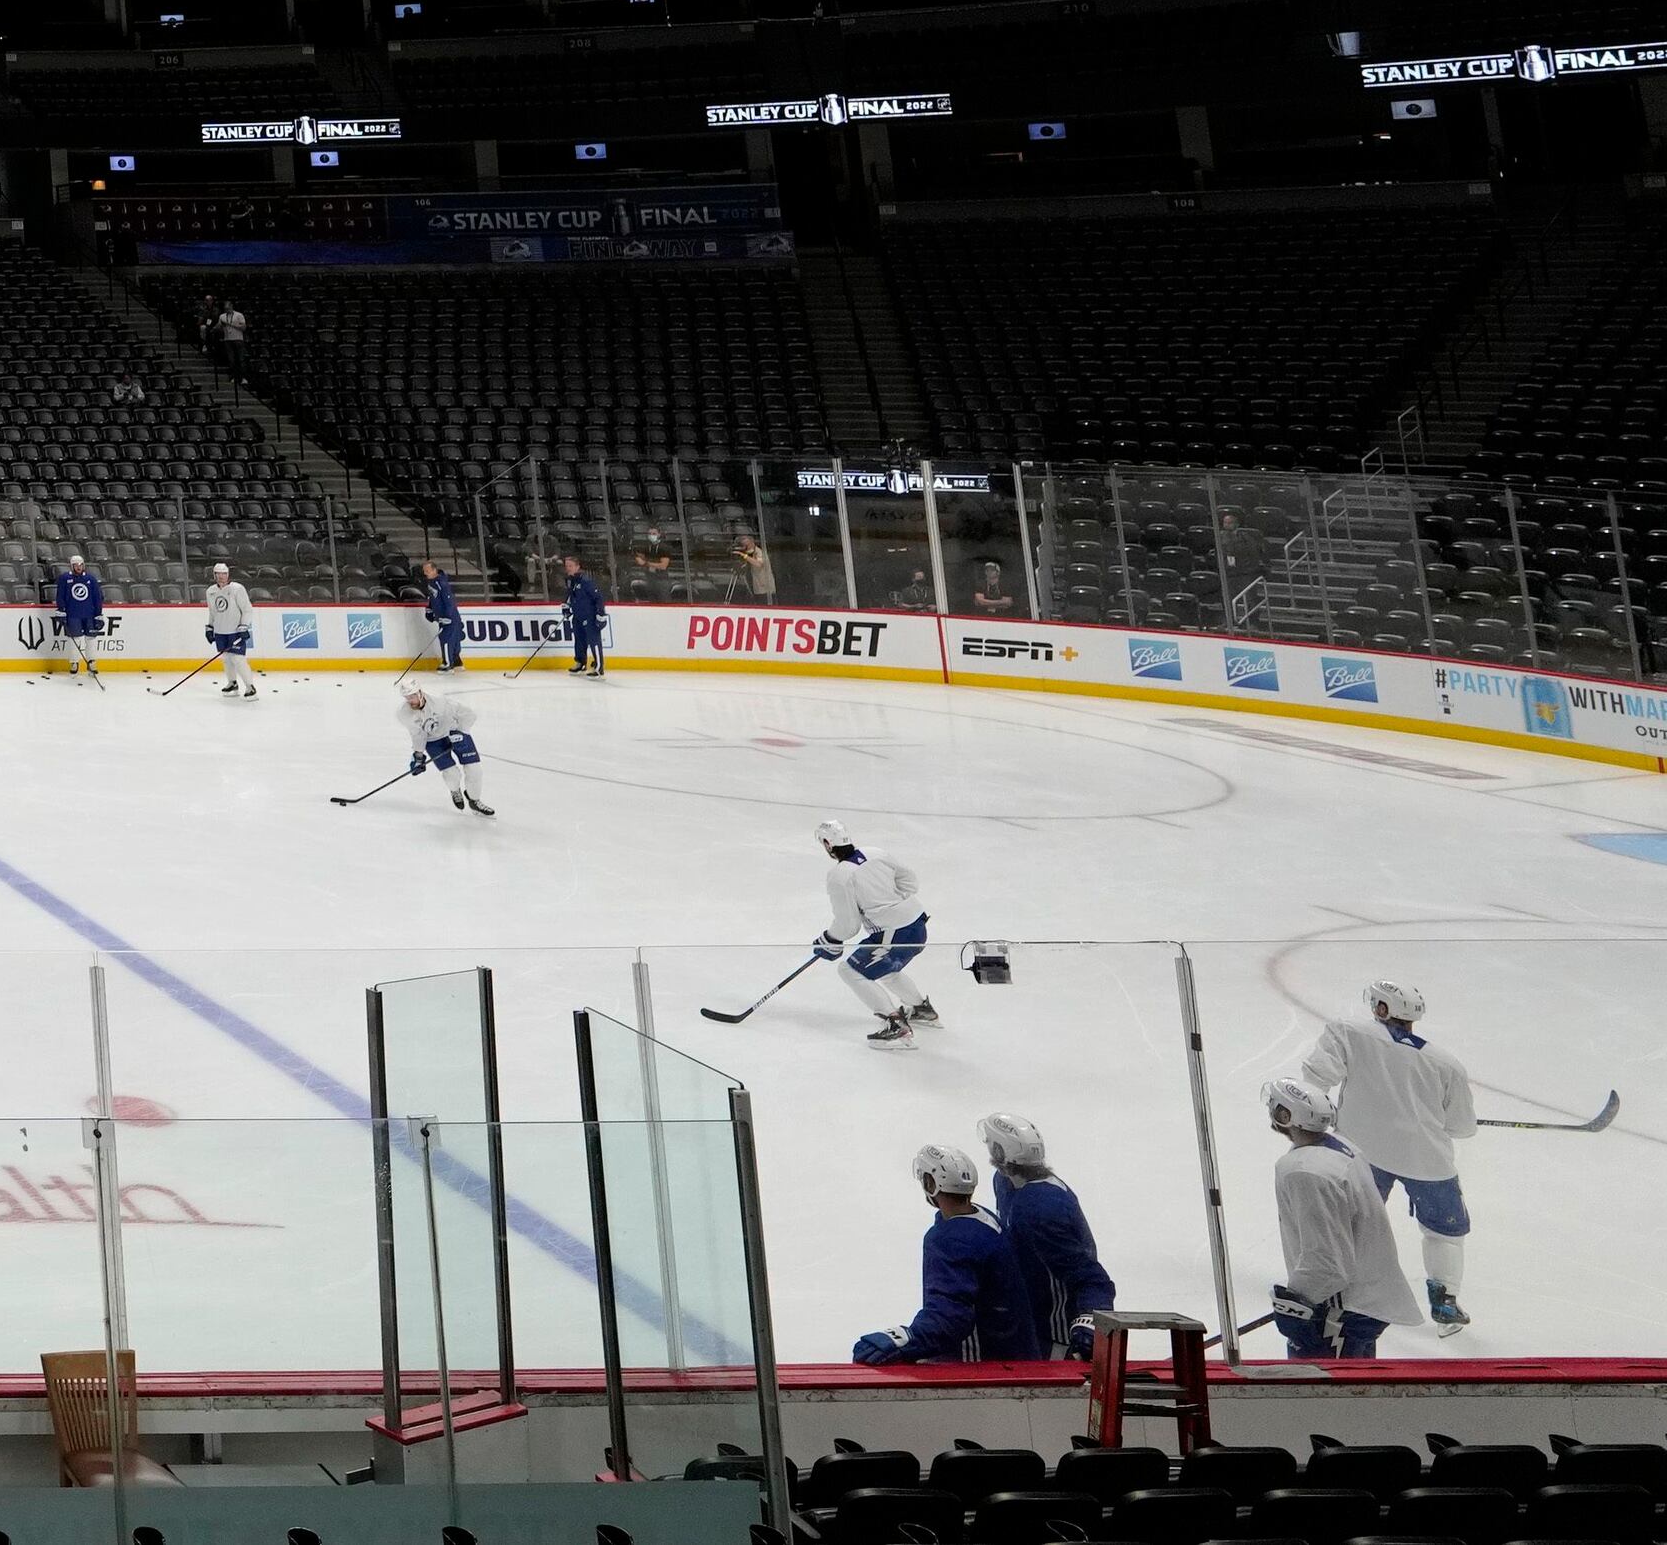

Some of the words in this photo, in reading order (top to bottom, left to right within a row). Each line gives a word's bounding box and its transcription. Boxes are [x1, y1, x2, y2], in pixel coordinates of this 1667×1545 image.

[159, 55, 179, 64] 206
[1361, 59, 1465, 84] STANLEY
[1469, 57, 1513, 77] CUP
[1556, 50, 1635, 71] FINAL
[707, 107, 780, 123] STANLEY
[783, 104, 818, 119] CUP
[848, 100, 904, 115] FINAL
[906, 101, 933, 111] 2022
[202, 126, 264, 139] STANLEY
[266, 125, 292, 137] CUP
[317, 123, 362, 136] FINAL
[364, 125, 386, 133] 2022
[453, 212, 551, 231] STANLEY
[558, 209, 603, 228] CUP
[640, 206, 718, 226] FINAL
[858, 475, 886, 488] CUP
[286, 618, 318, 638] Ball
[349, 618, 382, 638] Ball
[687, 615, 888, 657] POINTSBET
[1131, 647, 1180, 667] Ball
[1227, 656, 1276, 676] Ball
[1325, 666, 1375, 687] Ball
[1435, 668, 1517, 699] #PARTY
